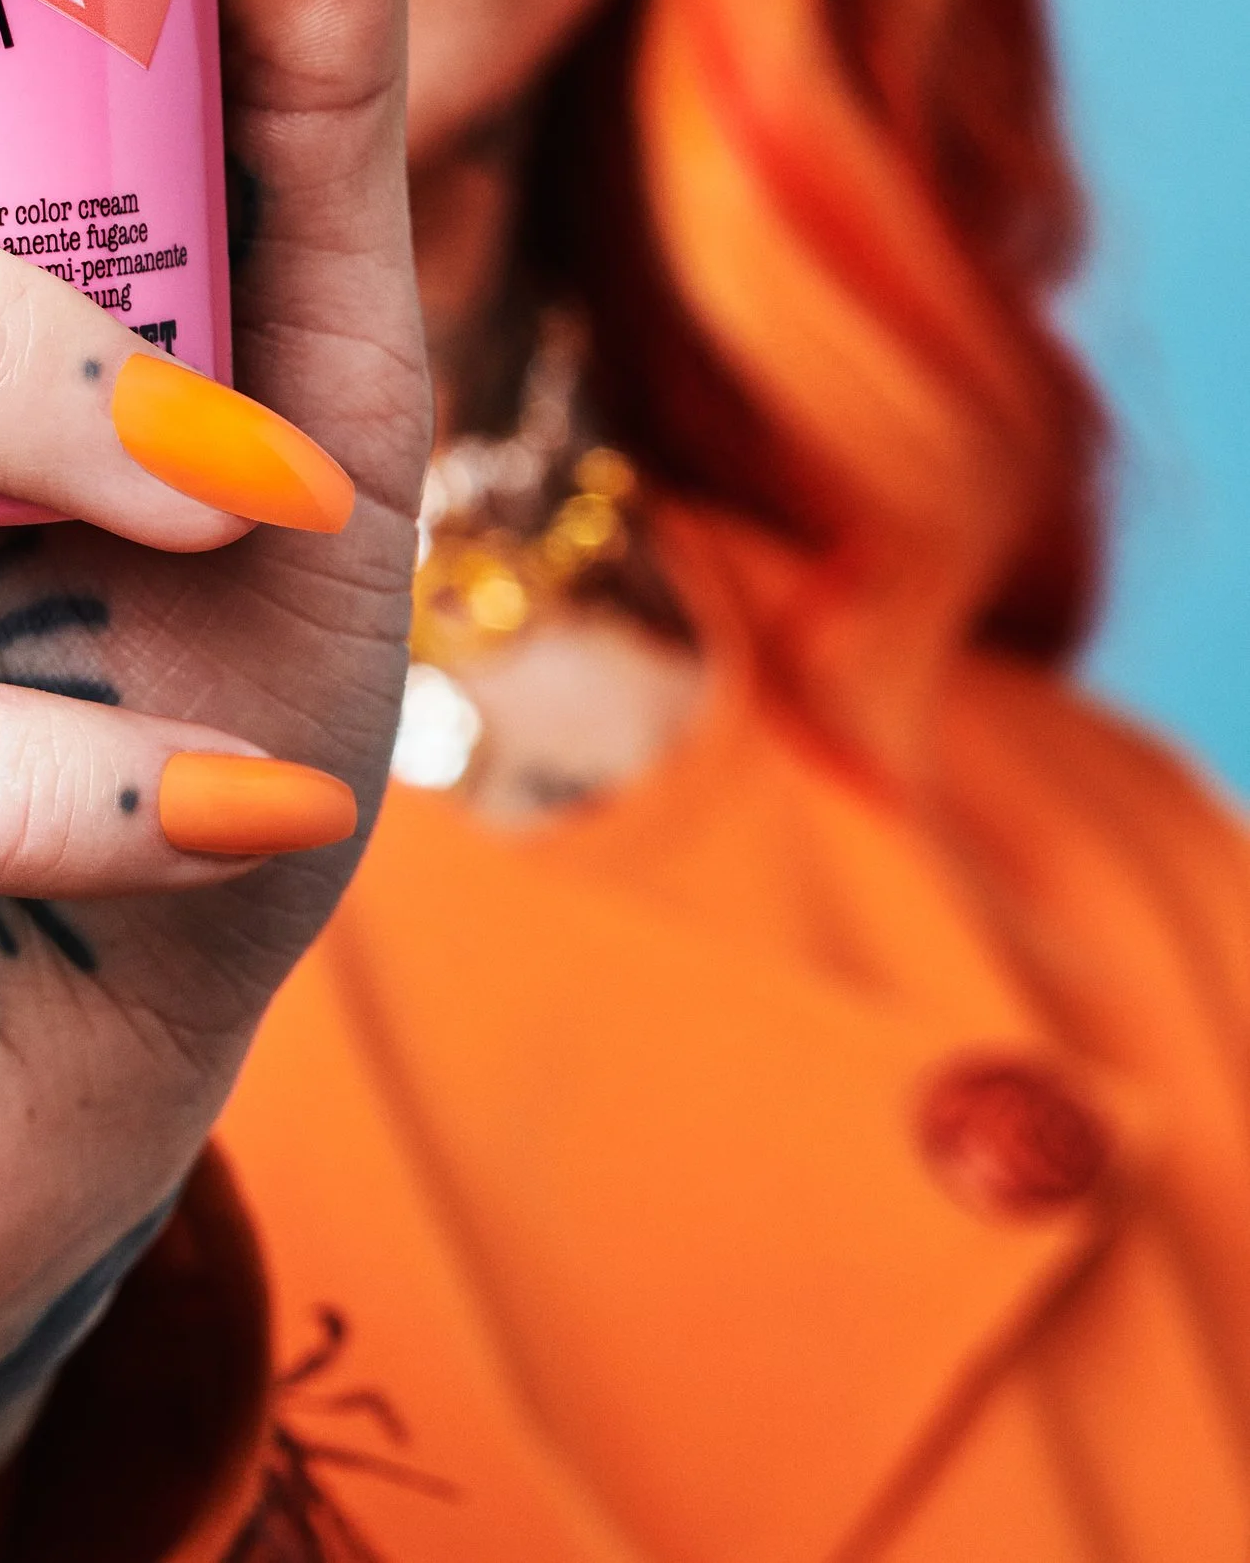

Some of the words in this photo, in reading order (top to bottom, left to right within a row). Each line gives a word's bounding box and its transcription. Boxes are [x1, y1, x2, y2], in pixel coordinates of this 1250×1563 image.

[15, 197, 72, 225] color
[78, 193, 140, 219] cream
[86, 222, 148, 252] fugace
[38, 243, 188, 286] mi-permanente
